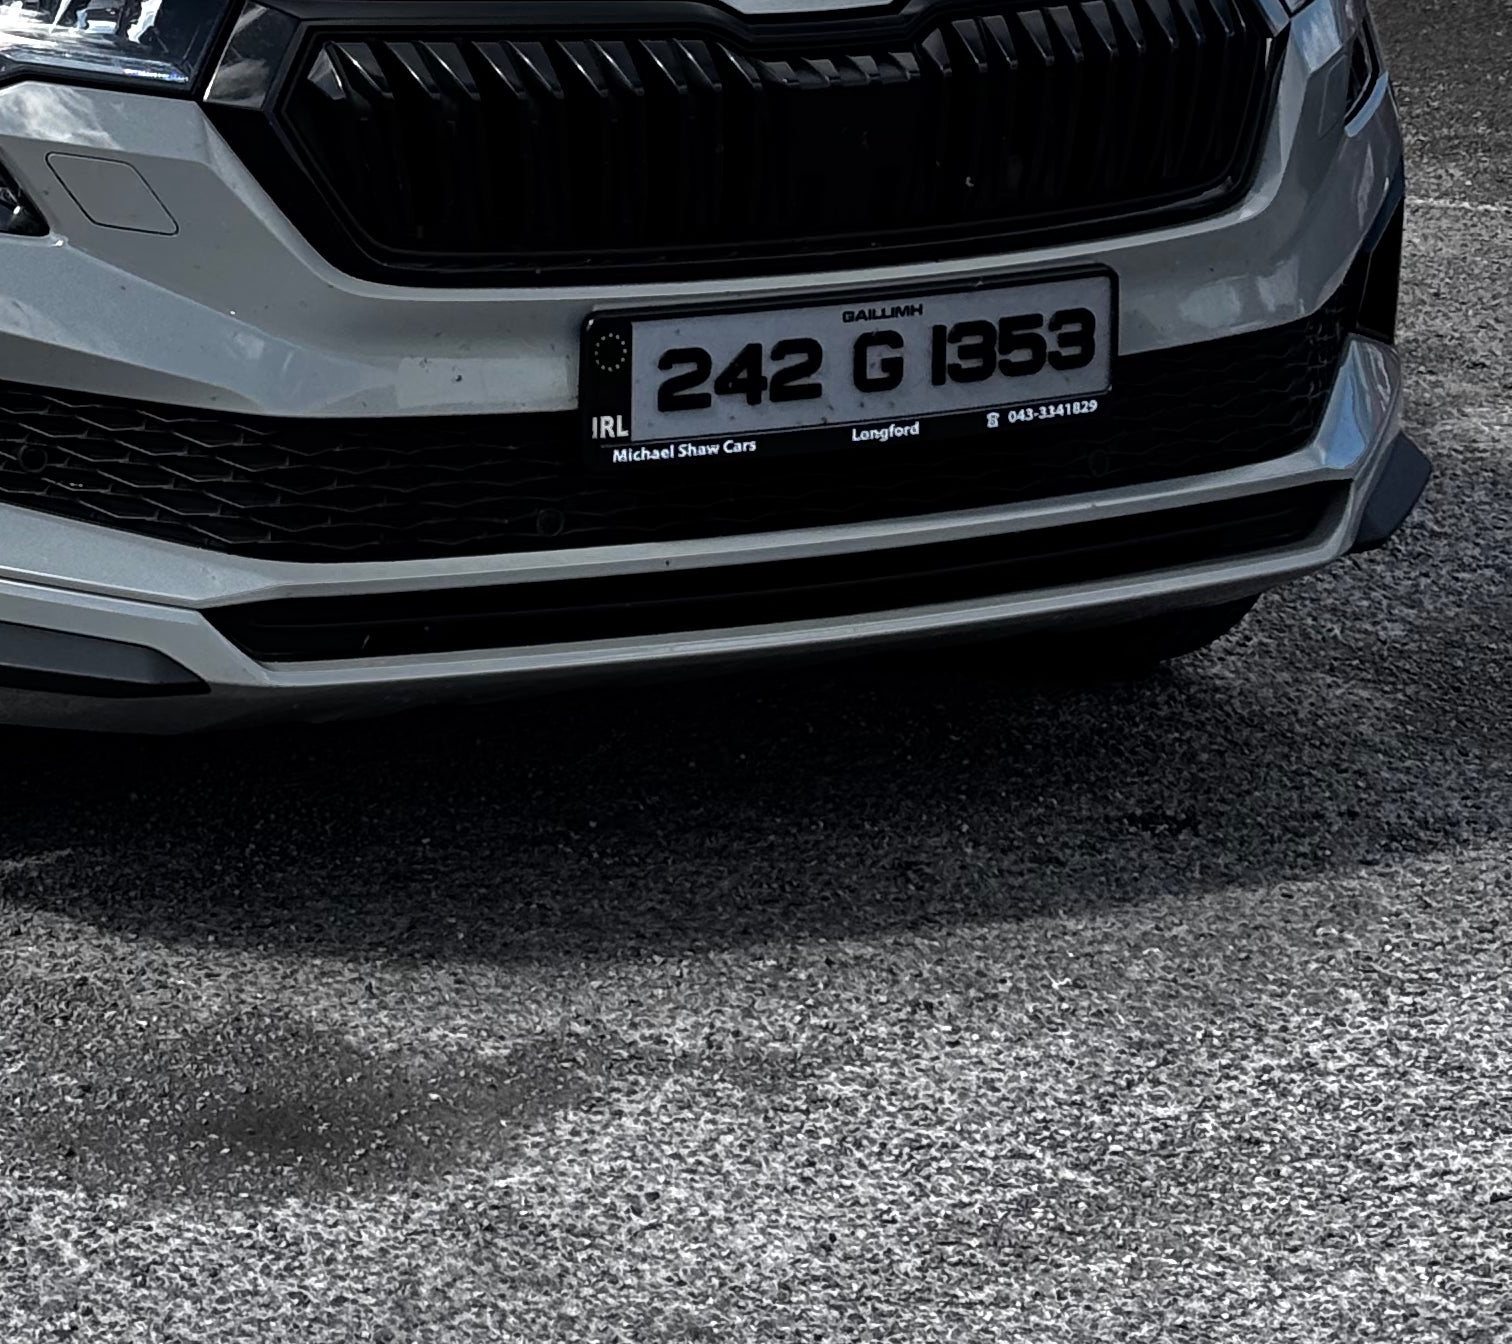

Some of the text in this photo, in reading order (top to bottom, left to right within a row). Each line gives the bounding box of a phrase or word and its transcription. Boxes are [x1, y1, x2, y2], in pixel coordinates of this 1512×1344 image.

[842, 304, 923, 324] GAILLIMH
[657, 307, 1097, 413] 242 G 1353
[1007, 398, 1099, 424] 043-3341829
[591, 415, 629, 440] IRL
[851, 421, 920, 443] Longford
[612, 439, 757, 464] Michael Shaw Cars
